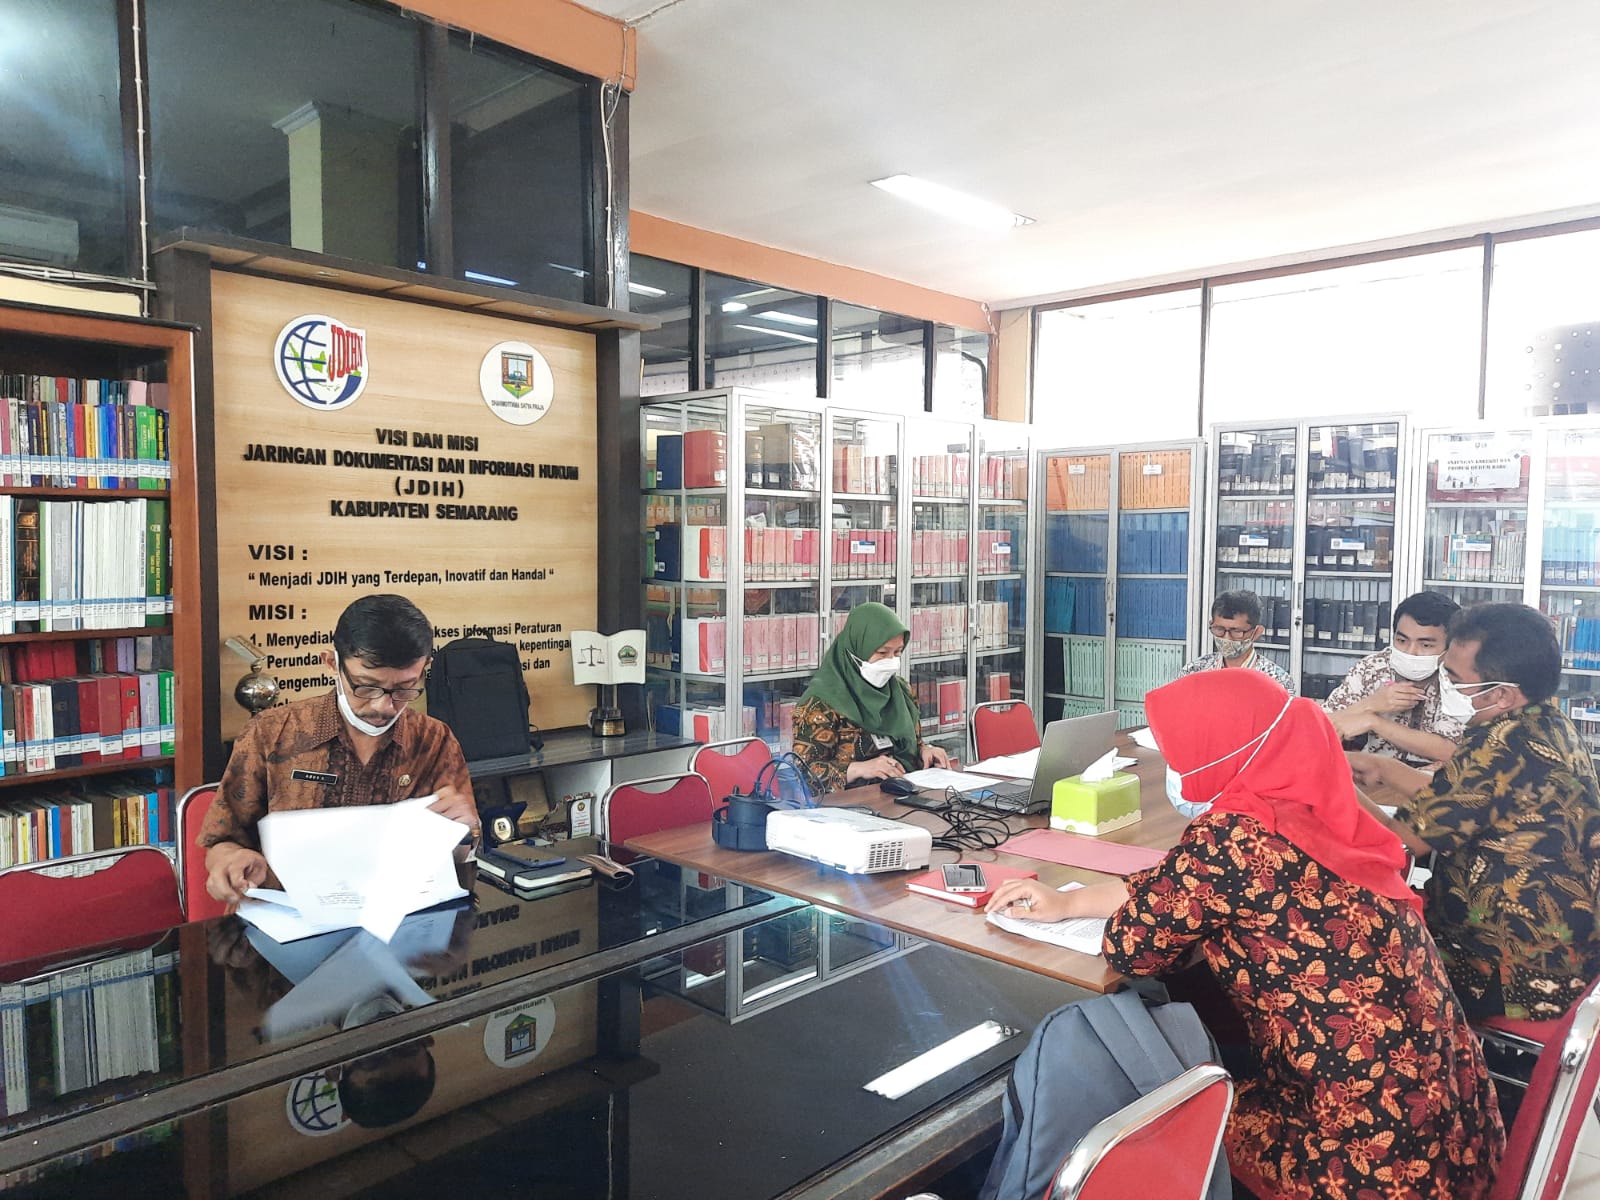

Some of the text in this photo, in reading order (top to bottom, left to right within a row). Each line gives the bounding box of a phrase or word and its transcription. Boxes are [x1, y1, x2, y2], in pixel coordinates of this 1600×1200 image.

[375, 428, 479, 452] VISI DAN MISI
[243, 444, 579, 481] JARINGAN DOKUMENTASI DAN INFORMASI HUKUM
[330, 500, 518, 522] KABUPATEN SEMARANG
[248, 544, 295, 561] VISI
[259, 572, 312, 590] Menjadi
[316, 570, 348, 586] JDIH
[351, 573, 380, 588] yang
[384, 569, 442, 586] Terdepan,
[445, 567, 486, 583] Inovatif
[489, 568, 509, 581] dan
[511, 567, 546, 581] Handal
[249, 605, 294, 620] MISI
[250, 633, 262, 647] 1.
[266, 630, 335, 649] Menyediak
[433, 625, 460, 638] kses
[514, 622, 561, 635] Peraturan
[533, 657, 550, 669] dan
